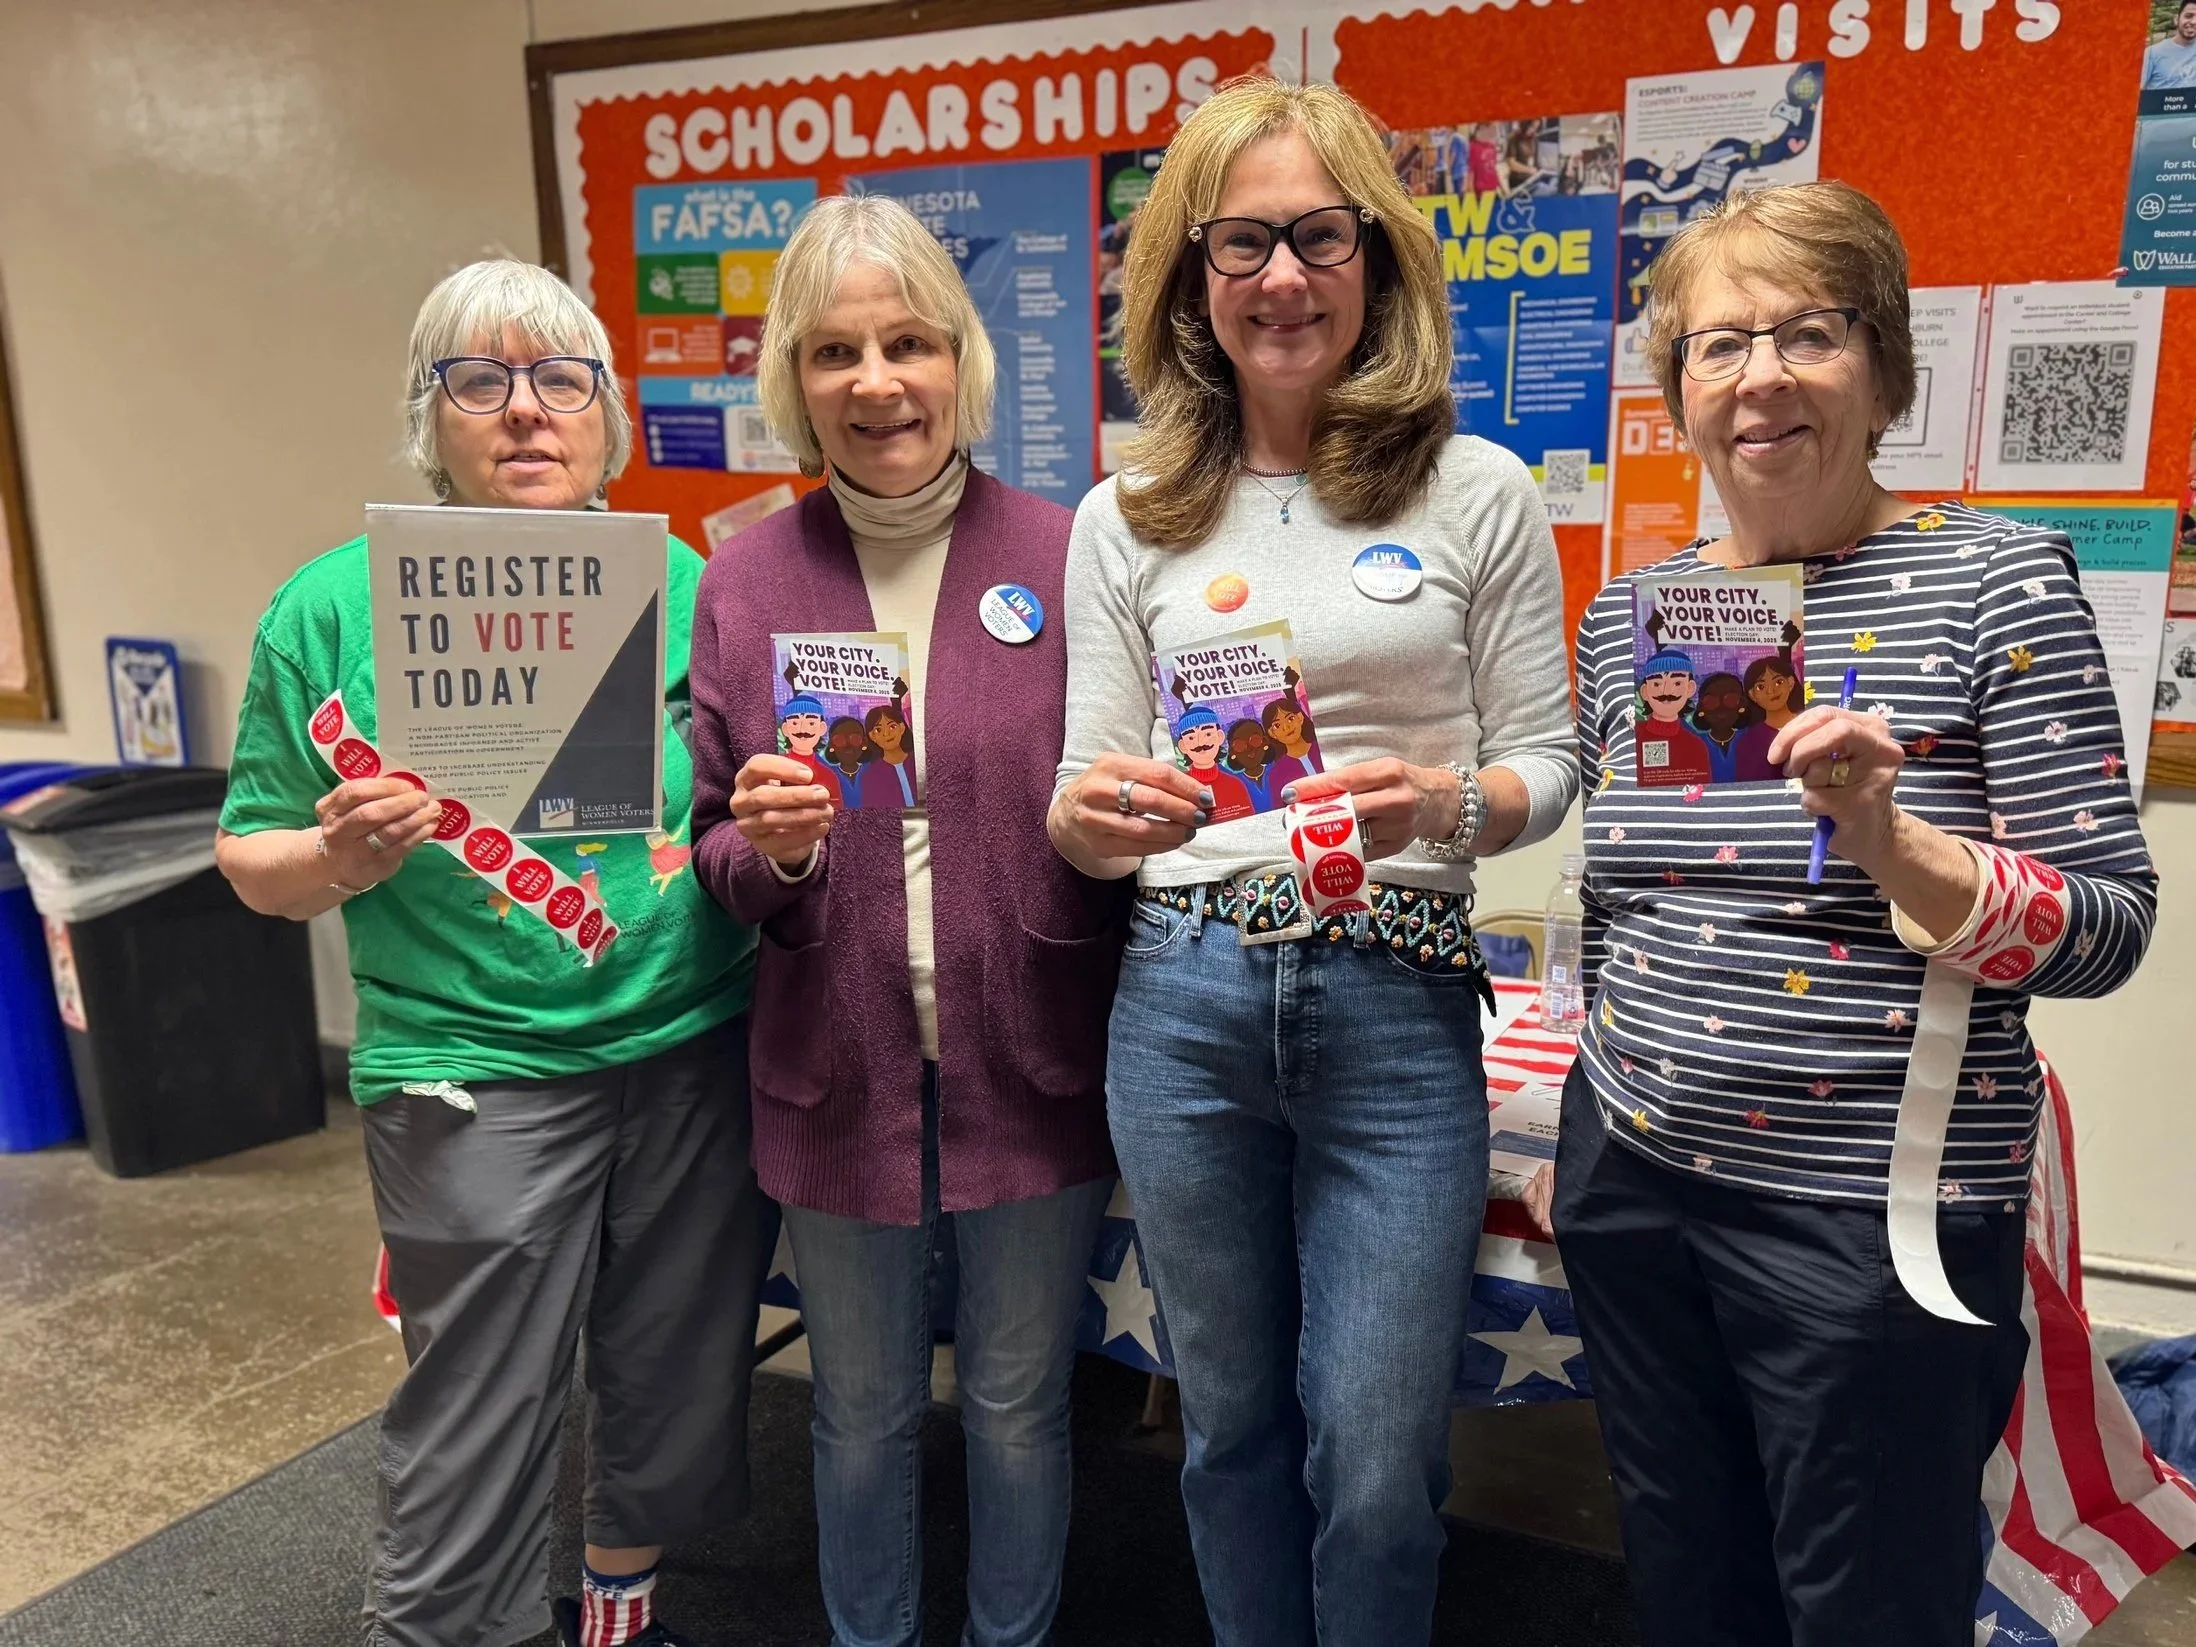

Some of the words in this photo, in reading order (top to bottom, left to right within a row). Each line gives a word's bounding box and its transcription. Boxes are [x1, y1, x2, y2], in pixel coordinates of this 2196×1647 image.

[1706, 0, 2061, 65] VISITS
[1730, 89, 1757, 100] CAMP
[645, 56, 1219, 179] SCHOLARSHIPS
[2164, 159, 2180, 169] for
[904, 190, 981, 213] NESOTA
[651, 198, 793, 242] FAFSA?
[1410, 189, 1497, 238] TW
[2153, 229, 2191, 239] Become
[1442, 228, 1593, 283] MSOE
[1910, 309, 1923, 318] EP
[1925, 307, 1957, 317] VISITS
[1909, 323, 1944, 333] HBURN
[1911, 337, 1950, 347] OLLEGE
[2051, 518, 2100, 532] SHINE.
[2105, 519, 2151, 532] BUILD.
[2071, 534, 2098, 545] mer
[2103, 533, 2143, 551] Camp
[1371, 551, 1403, 565] LWV
[398, 555, 603, 598] REGISTER
[1007, 590, 1036, 617] LWV
[1657, 587, 1712, 604] YOUR
[1715, 587, 1767, 605] CITY.
[984, 611, 1009, 637] VOTERS
[989, 606, 1013, 632] WOMEN
[990, 597, 1015, 624] LEAGUE
[1012, 622, 1022, 631] OF
[1660, 606, 1715, 623] YOUR
[1717, 607, 1784, 626] VOICE.
[400, 613, 450, 655] TO
[474, 611, 575, 653] VOTE
[1664, 624, 1723, 643] VOTE!
[792, 642, 836, 660] YOUR
[838, 646, 880, 663] CITY.
[1174, 650, 1222, 668] YOUR
[1222, 643, 1267, 662] CITY.
[795, 658, 840, 676] YOUR
[841, 662, 895, 681] VOICE.
[1181, 666, 1228, 683] YOUR
[1227, 659, 1285, 678] VOICE.
[404, 666, 538, 709] TODAY
[799, 673, 847, 692] VOTE!
[1186, 680, 1238, 698] VOTE!
[316, 706, 337, 726] WILL
[318, 714, 339, 736] VOTE
[339, 743, 347, 752] I
[341, 747, 364, 767] WILL
[349, 755, 374, 777] VOTE
[487, 760, 547, 768] UNDERSTANDING
[438, 807, 453, 821] ILL
[581, 803, 618, 813] LEAGUE
[619, 802, 633, 810] OF
[581, 811, 618, 820] WOMEN
[619, 808, 655, 816] VOTERS
[439, 811, 464, 834] VOTE
[1312, 821, 1344, 836] WILL
[470, 835, 479, 843] I
[472, 836, 497, 858] WILL
[1327, 835, 1334, 845] I
[481, 841, 507, 865] VOTE
[511, 866, 521, 874] I
[514, 866, 539, 889] WILL
[1320, 863, 1353, 877] VOTE
[523, 871, 549, 896] VOTE
[1323, 875, 1355, 888] WILL
[1338, 888, 1344, 896] I
[553, 894, 574, 915] WILL
[561, 897, 581, 921] VOTE
[2035, 904, 2058, 924] VOTE
[618, 913, 661, 930] LEAGUE
[620, 922, 666, 938] WOMEN
[2032, 916, 2052, 936] WILL
[2032, 934, 2039, 943] I
[1990, 963, 2012, 977] WILL
[2000, 954, 2024, 971] VOTE
